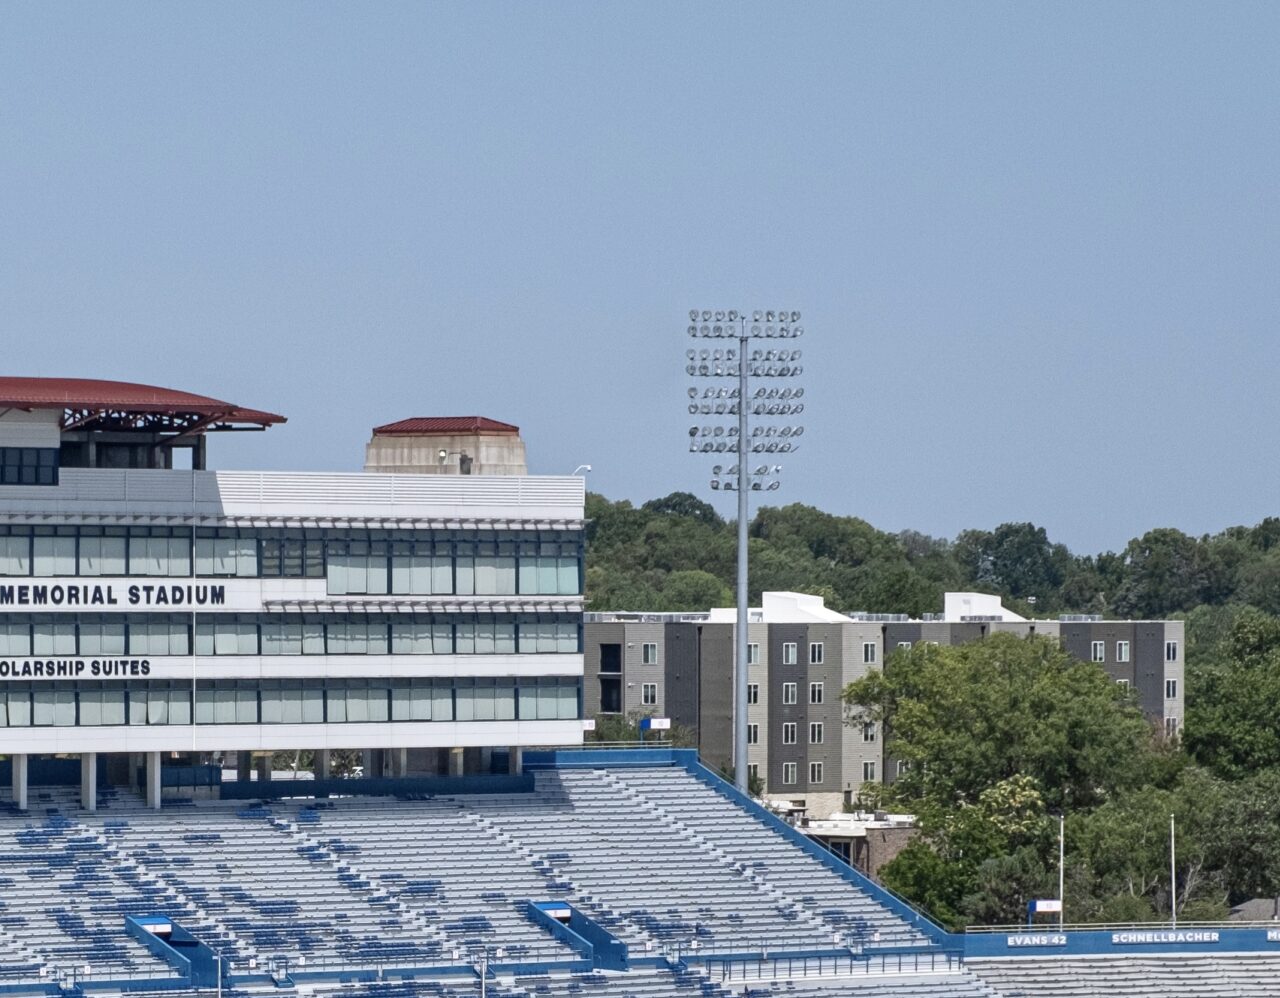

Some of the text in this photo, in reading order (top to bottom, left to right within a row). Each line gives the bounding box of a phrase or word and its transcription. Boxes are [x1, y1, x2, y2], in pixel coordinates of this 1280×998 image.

[0, 584, 118, 605] MEMORIAL
[128, 584, 226, 605] STADIUM
[90, 660, 151, 676] SUITES
[1007, 935, 1067, 945] EVANS 42
[1112, 932, 1219, 943] SCHNELLBACHER
